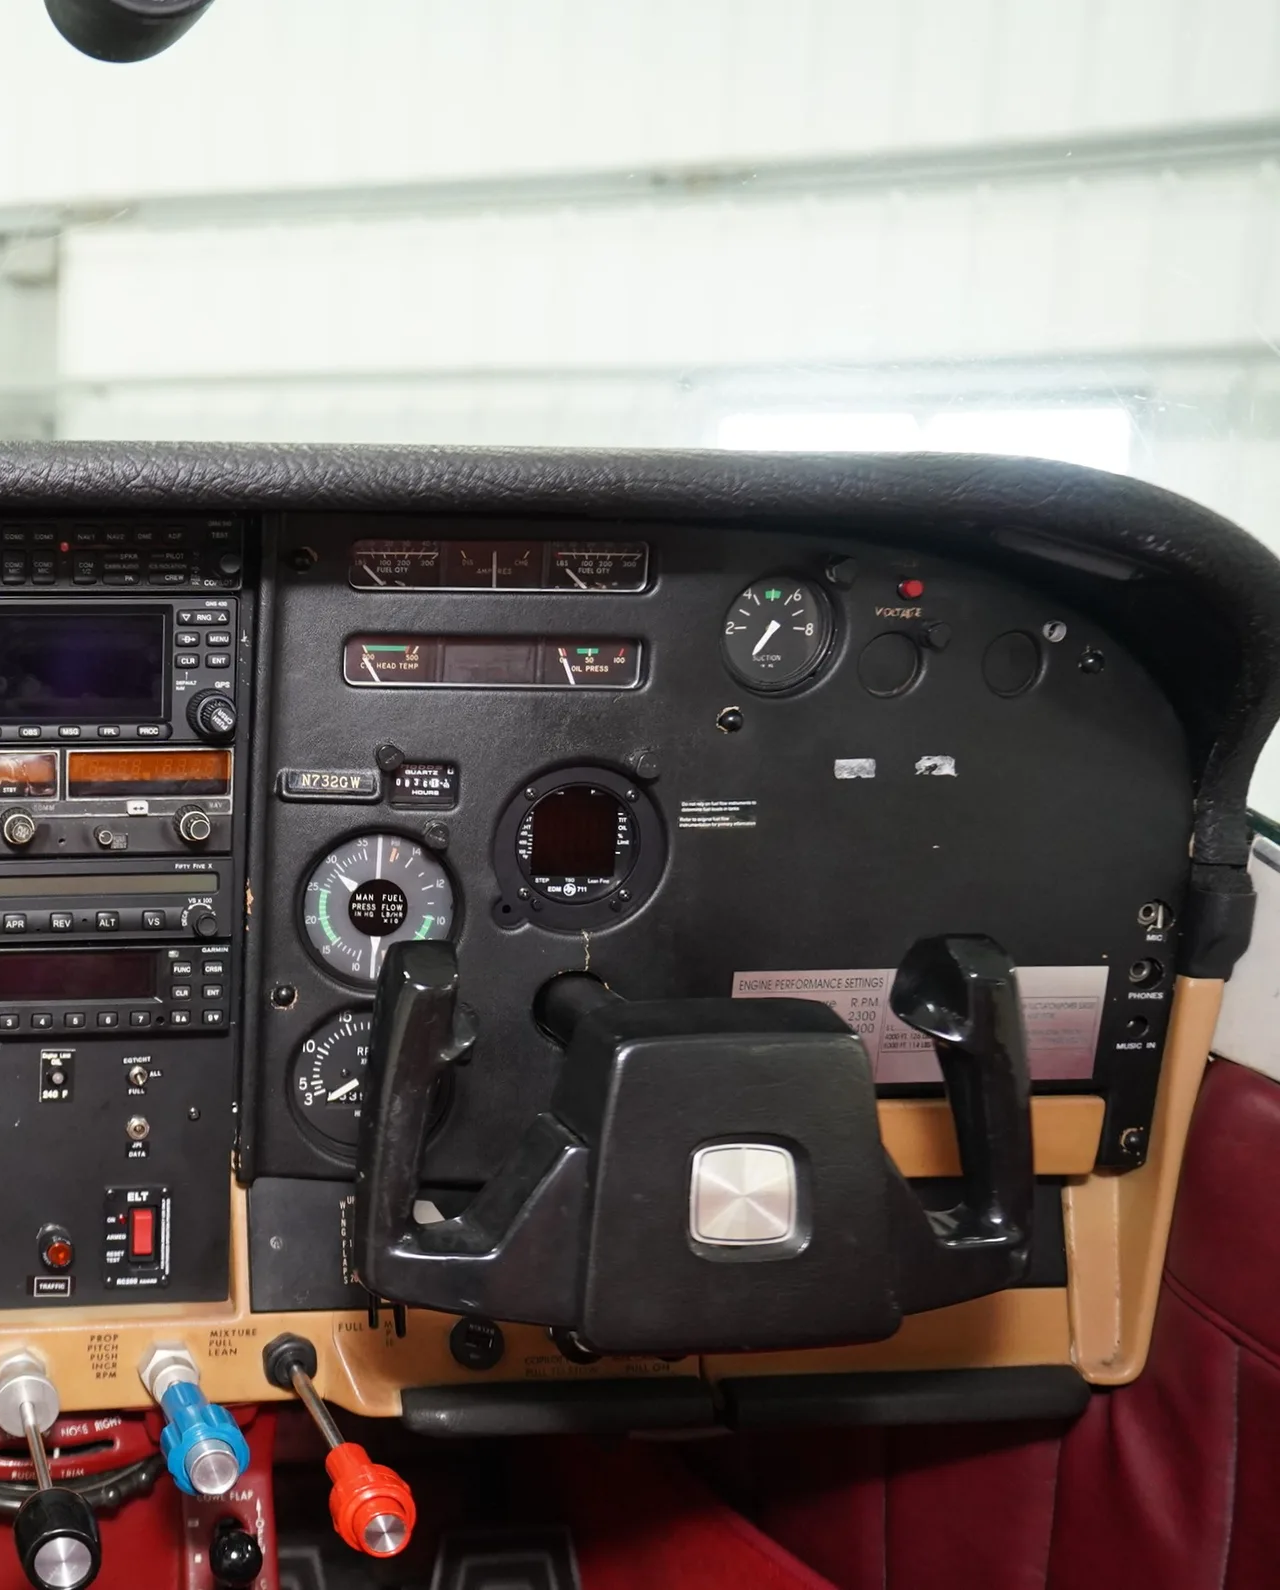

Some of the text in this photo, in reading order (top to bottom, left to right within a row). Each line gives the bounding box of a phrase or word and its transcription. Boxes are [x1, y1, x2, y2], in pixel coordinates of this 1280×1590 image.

[77, 532, 96, 541] NAV1
[210, 532, 229, 540] TEST
[119, 553, 139, 561] SPKR
[165, 553, 185, 561] PILOT
[78, 561, 94, 570] COM
[397, 559, 412, 567] 200
[598, 560, 614, 568] 200
[376, 566, 409, 574] FUEL QTY
[577, 567, 611, 575] FUEL QTY
[123, 575, 134, 583] PA
[164, 574, 185, 582] CREW
[741, 587, 753, 601] 4
[792, 587, 803, 602] 6
[196, 614, 213, 622] RNG
[724, 621, 735, 636] 2
[804, 622, 814, 637] 8
[209, 636, 229, 644] MENU
[405, 653, 420, 661] 500
[584, 656, 595, 664] 50
[613, 656, 626, 664] 100
[751, 654, 782, 662] SUCTION
[180, 658, 196, 666] CLR
[211, 658, 226, 666] ENT
[376, 661, 420, 670] HEAD TEMP
[571, 664, 610, 673] OIL PRESS
[214, 681, 232, 690] GPS
[62, 728, 79, 736] MSG
[139, 728, 159, 736] PROC
[302, 773, 362, 789] N732GW
[411, 847, 422, 857] 14
[307, 881, 320, 892] 25
[435, 878, 446, 889] 12
[355, 894, 374, 902] MAN
[381, 893, 404, 902] FUEL
[351, 903, 377, 911] PRESS
[381, 903, 404, 912] FLOW
[6, 920, 25, 928] APR
[52, 919, 72, 928] REV
[99, 918, 116, 927] ALT
[147, 917, 162, 926] VS
[304, 915, 317, 925] 20
[436, 917, 446, 926] 10
[1146, 934, 1164, 942] MIC
[322, 945, 331, 955] 15
[351, 962, 361, 972] 10
[738, 976, 885, 992] ENGINE PERFORMANCE SETTINGS
[1127, 992, 1164, 1000] PHONES
[338, 1013, 353, 1023] 15
[847, 1010, 877, 1022] 2300
[302, 1038, 316, 1054] 10
[1115, 1042, 1156, 1050] MUSIC IN
[298, 1077, 308, 1091] 5
[128, 1088, 145, 1096] FULL
[303, 1093, 314, 1106] 3
[128, 1150, 147, 1158] DATA
[127, 1191, 149, 1202] ELT
[39, 1282, 66, 1290] TRAFFIC
[338, 1322, 365, 1333] FULL
[209, 1328, 257, 1339] MIXTURE
[89, 1334, 120, 1343] PROP
[87, 1343, 119, 1352] PITCH
[208, 1339, 233, 1348] PULL
[89, 1353, 119, 1362] PUSH
[207, 1348, 238, 1358] LEAN
[95, 1372, 117, 1380] RPM
[60, 1418, 123, 1437] NOSE RIGHT
[60, 1467, 85, 1478] TRIM
[229, 1489, 254, 1501] FLAP
